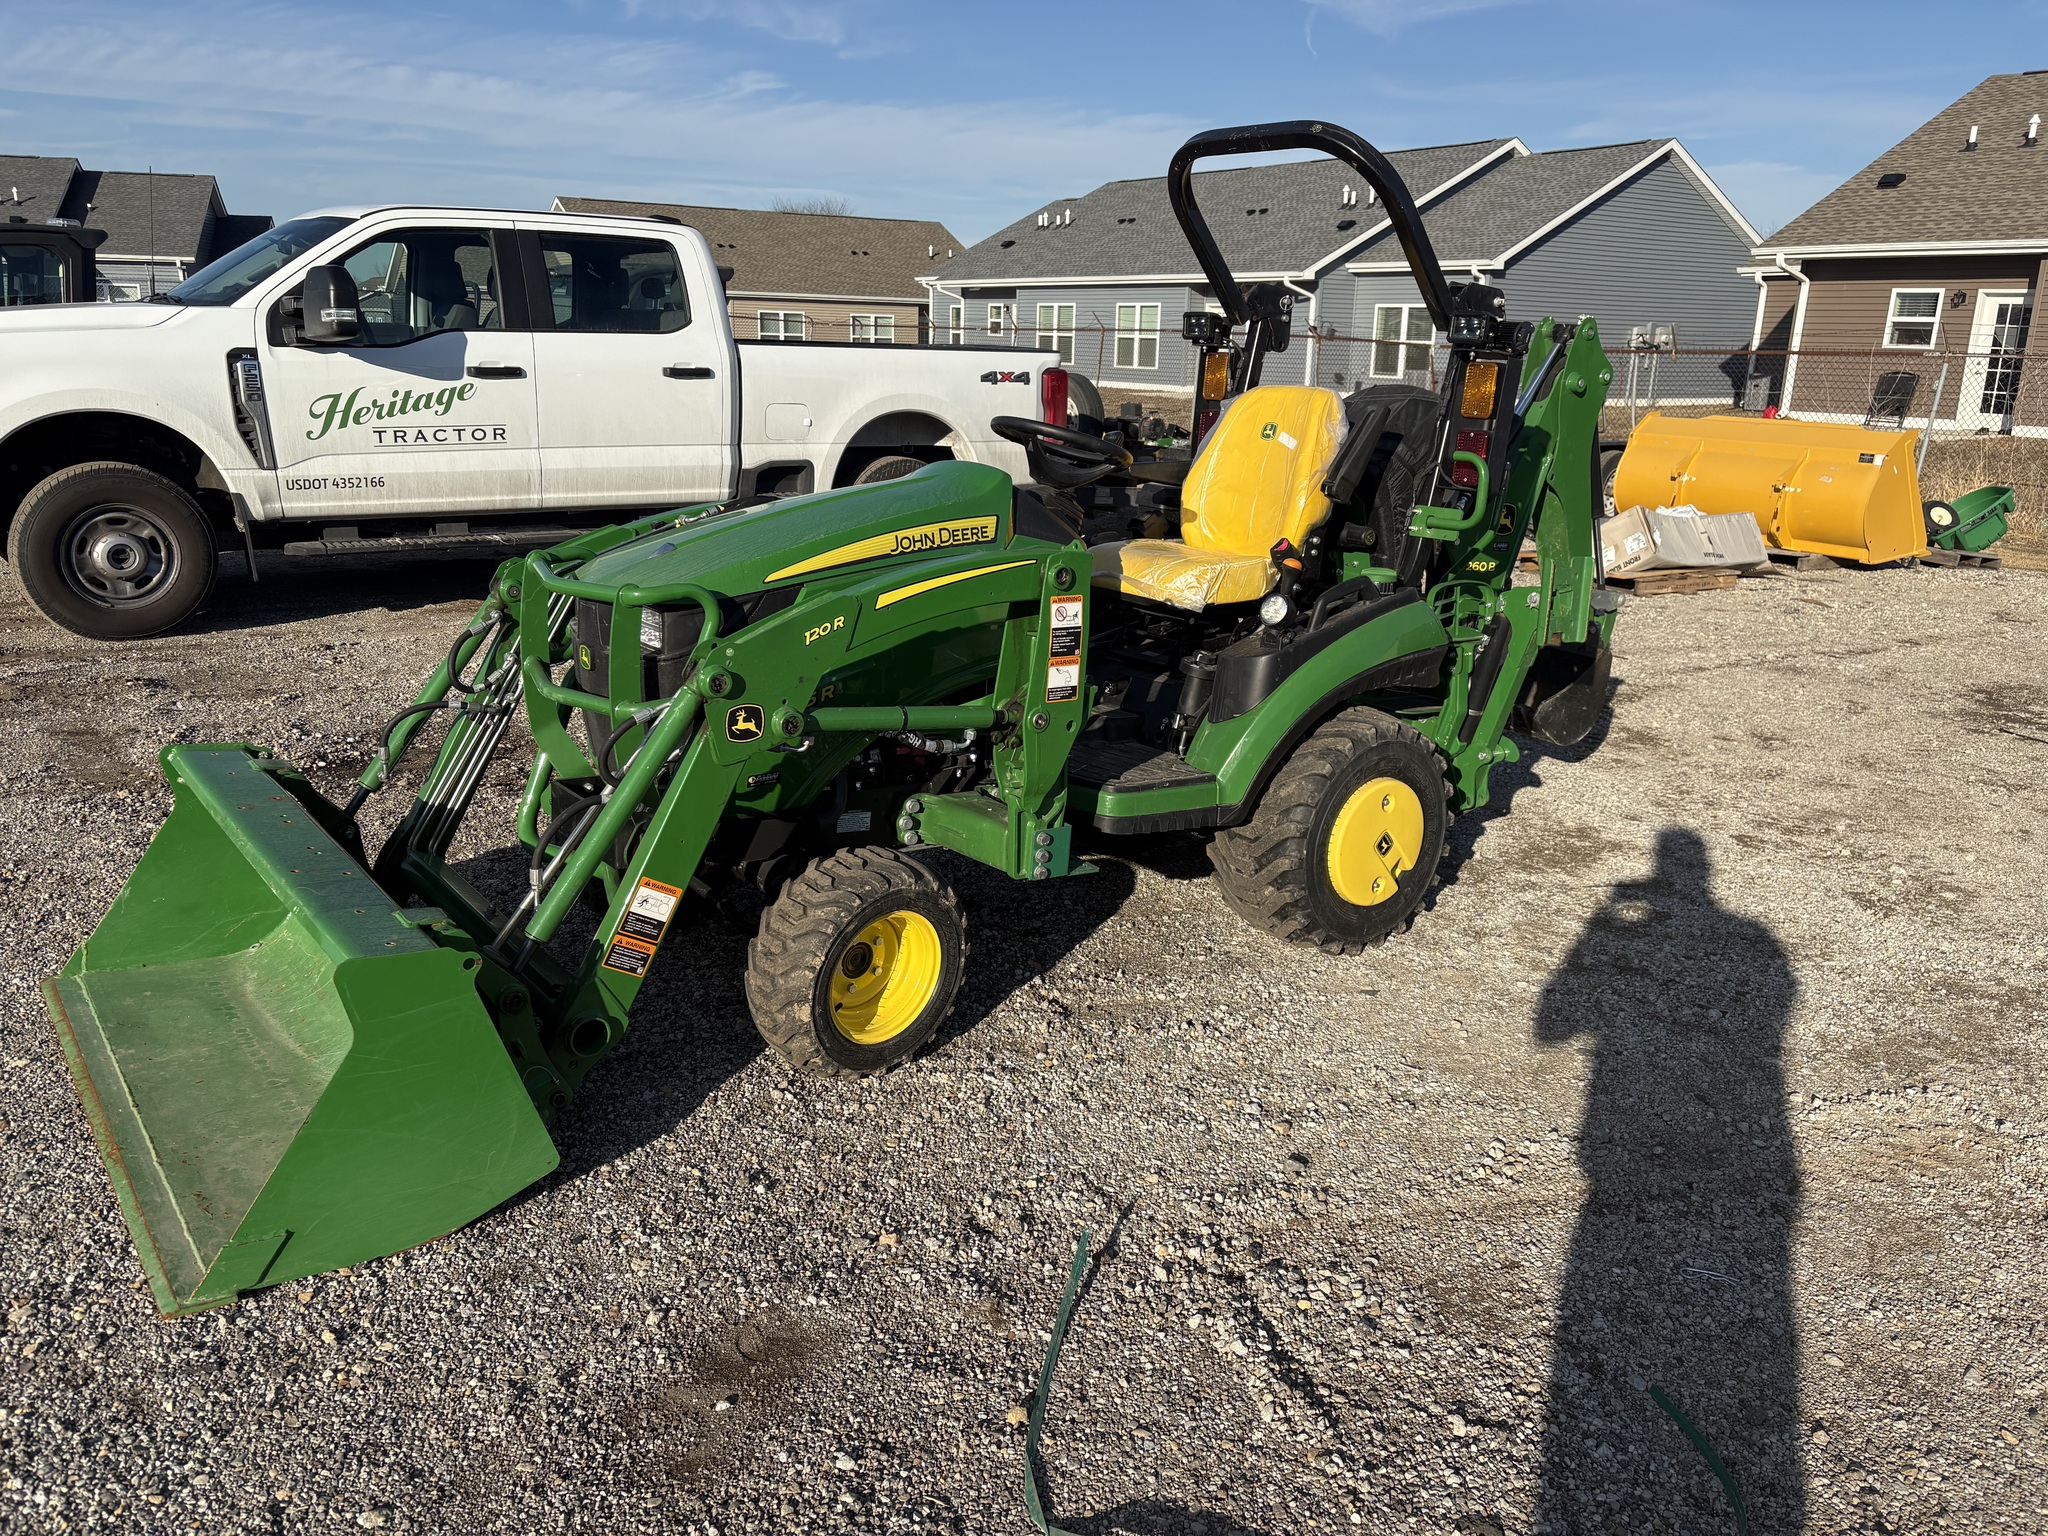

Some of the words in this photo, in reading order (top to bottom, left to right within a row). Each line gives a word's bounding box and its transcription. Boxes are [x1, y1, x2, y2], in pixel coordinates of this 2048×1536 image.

[306, 383, 477, 440] Heritage
[373, 427, 507, 444] TRACTOR
[286, 478, 329, 490] USDOT
[331, 476, 385, 489] 4352166
[890, 532, 935, 553] JOHN
[938, 526, 990, 545] DEERE
[1054, 658, 1079, 666] WARNING
[651, 882, 677, 894] WARNING
[624, 940, 651, 952] WARNING
